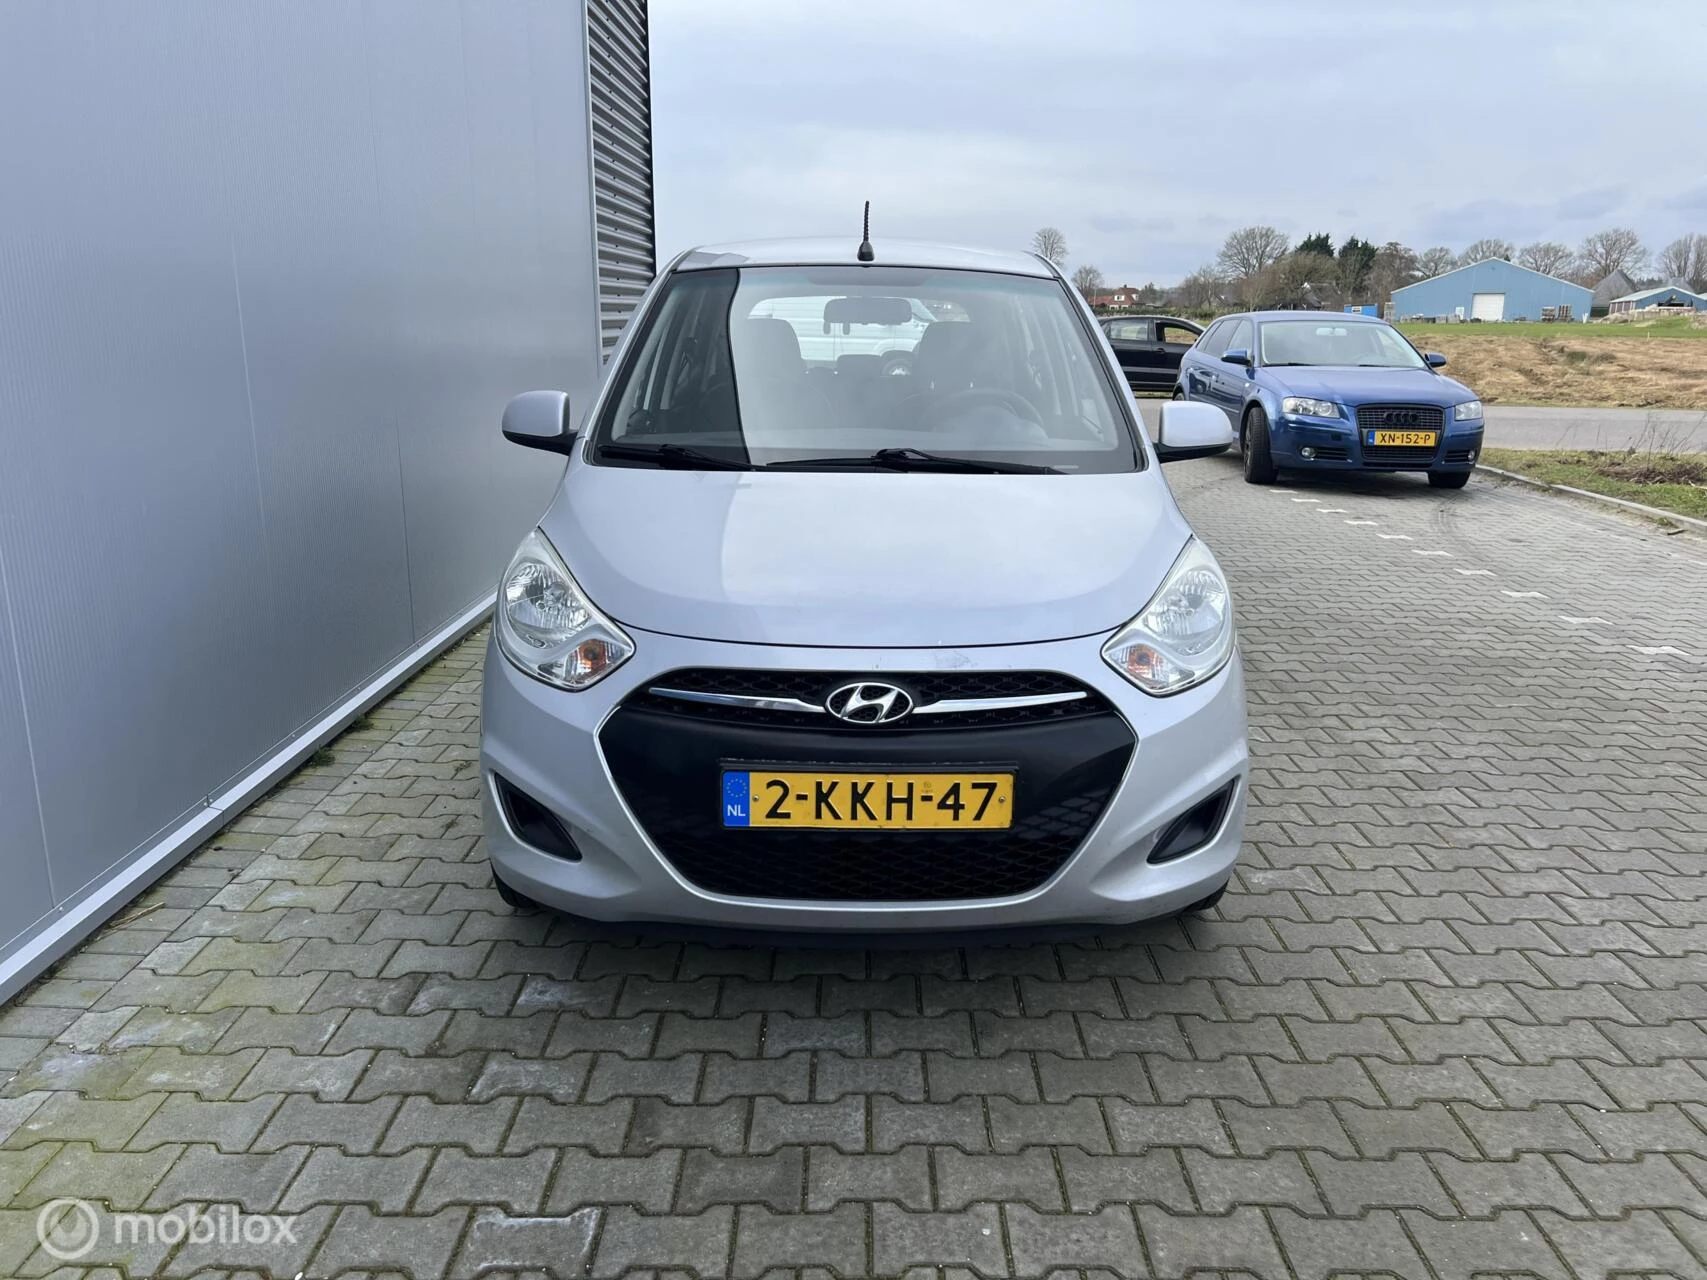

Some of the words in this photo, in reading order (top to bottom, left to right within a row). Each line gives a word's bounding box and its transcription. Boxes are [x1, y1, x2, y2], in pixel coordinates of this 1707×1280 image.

[1380, 433, 1431, 444] XN-152-P
[765, 779, 998, 821] 2-KKH-47
[727, 804, 746, 817] NL
